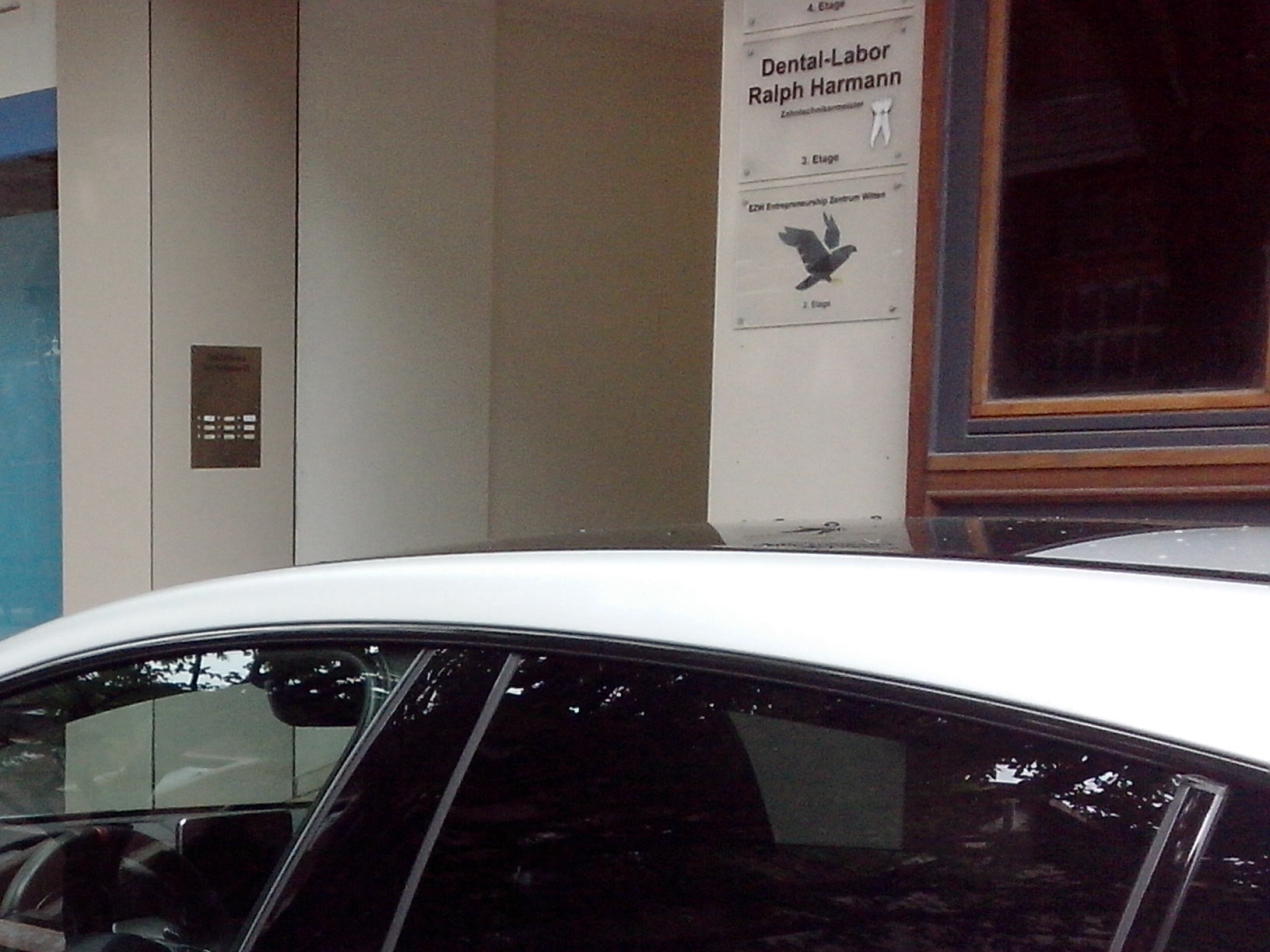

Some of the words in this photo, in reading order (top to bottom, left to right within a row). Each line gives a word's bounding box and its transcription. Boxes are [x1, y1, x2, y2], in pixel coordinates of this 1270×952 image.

[761, 44, 891, 77] Dental-Labor
[748, 81, 804, 106] Ralph
[810, 71, 902, 98] Harmann
[812, 153, 839, 165] Etage
